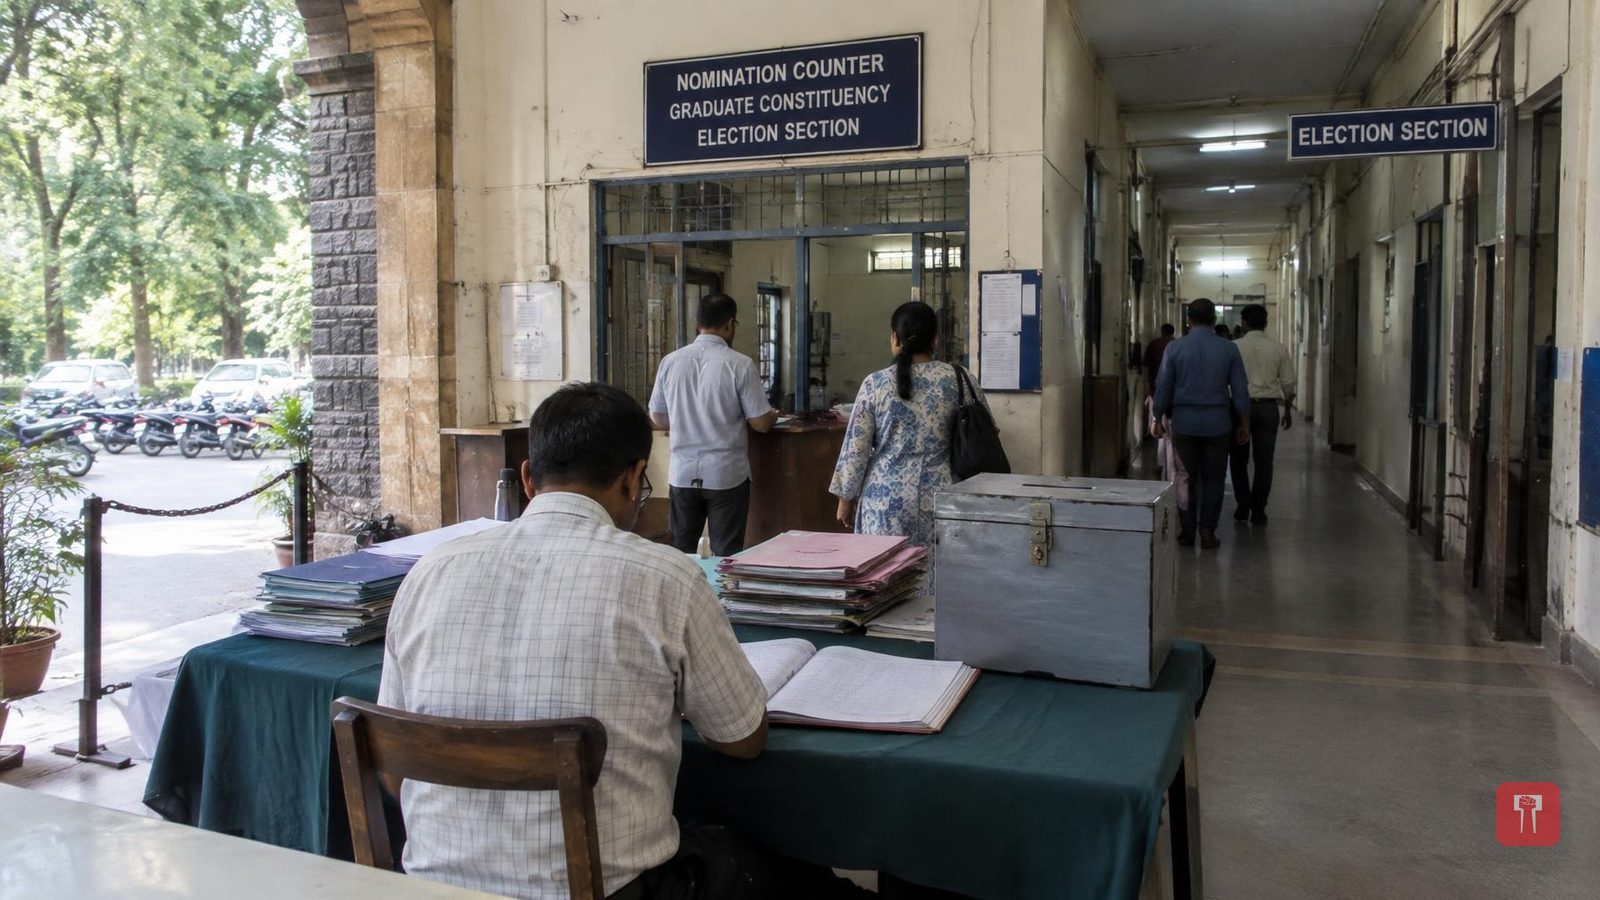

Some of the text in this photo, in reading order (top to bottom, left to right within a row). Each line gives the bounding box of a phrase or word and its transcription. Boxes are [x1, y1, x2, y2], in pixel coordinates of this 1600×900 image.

[676, 53, 885, 92] NOMINATION COUNTER
[669, 83, 892, 120] GRADUATE CONSTITUENCY
[697, 117, 860, 147] ELECTION SECTION
[1298, 117, 1488, 146] ELECTION SECTION
